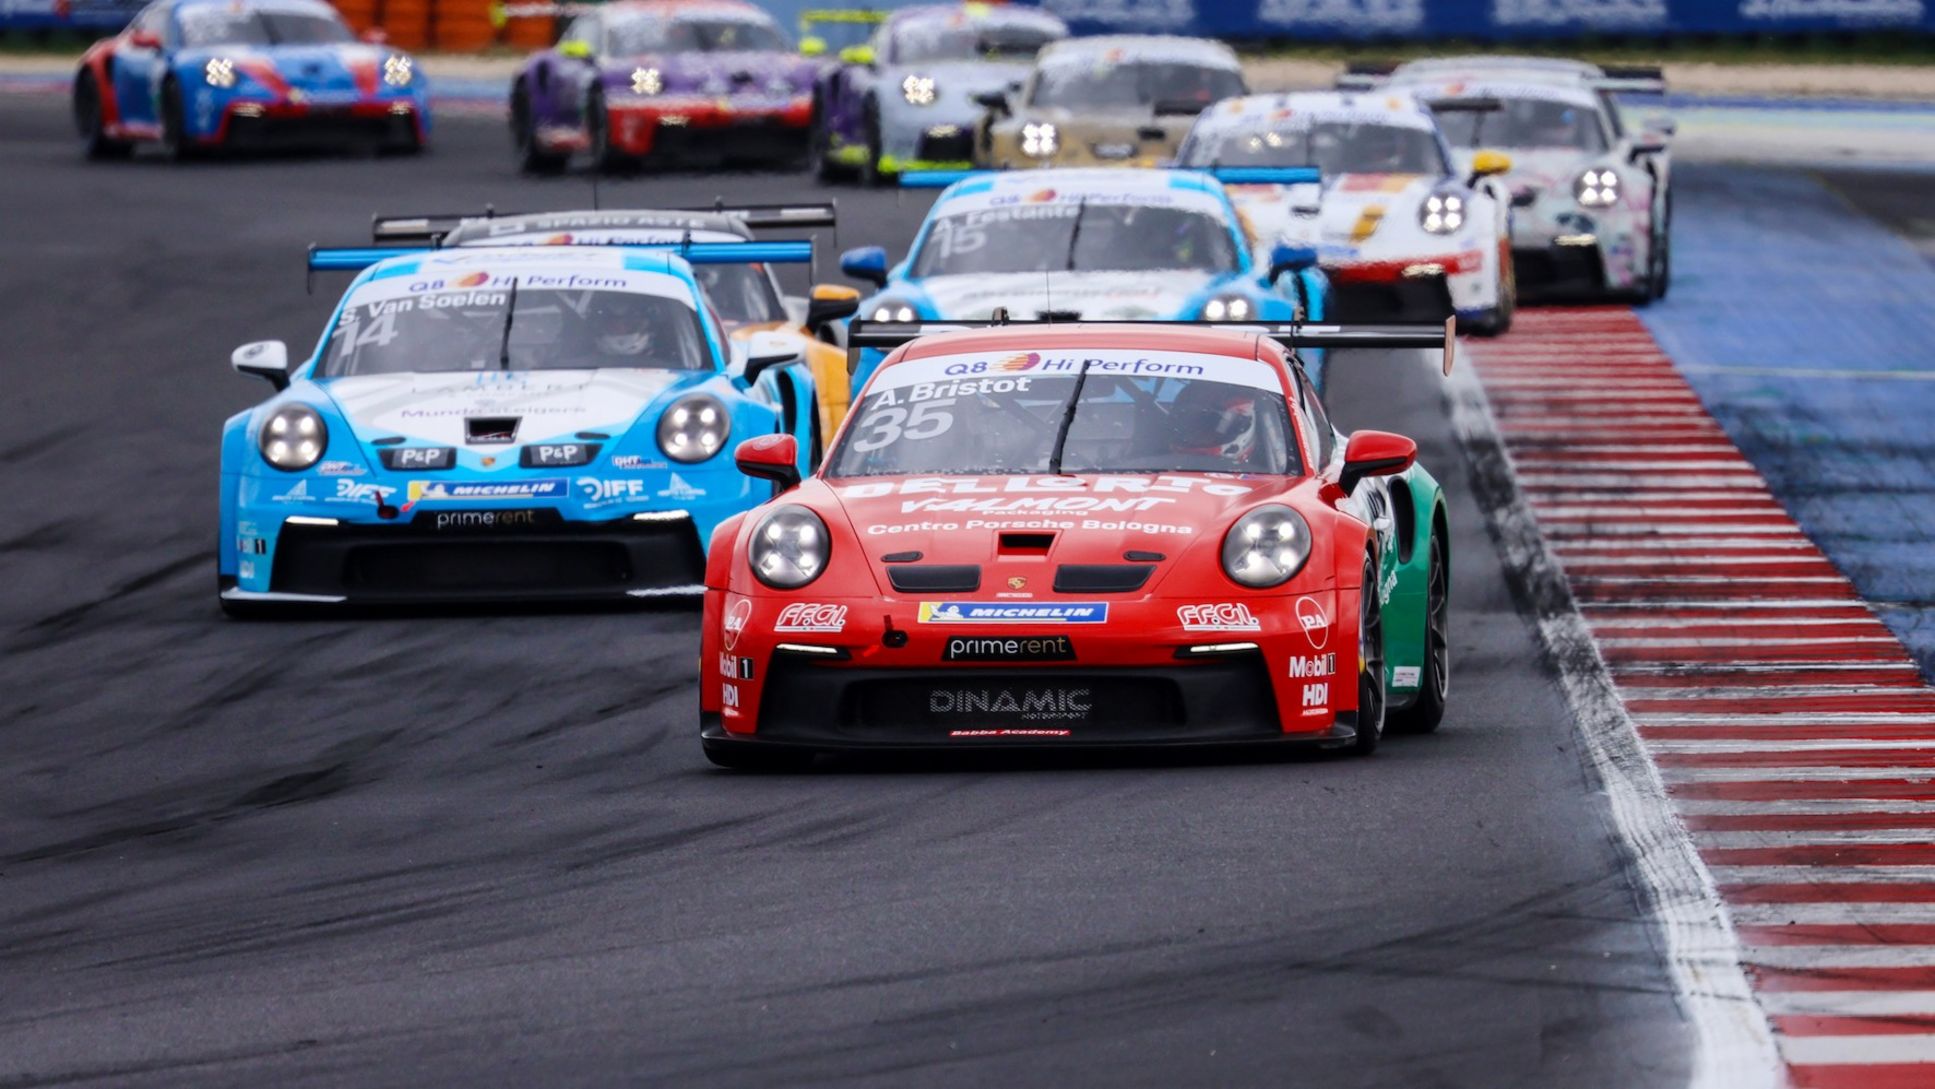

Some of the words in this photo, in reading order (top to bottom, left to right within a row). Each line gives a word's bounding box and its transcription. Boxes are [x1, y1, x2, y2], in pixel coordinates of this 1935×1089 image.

[931, 224, 986, 259] 15
[409, 279, 445, 293] Q8
[527, 274, 627, 288] Perform
[339, 308, 361, 326] S.
[367, 299, 413, 318] Van
[418, 291, 506, 310] Soelen
[332, 311, 398, 358] 14
[944, 361, 989, 377] Q8
[1042, 357, 1070, 372] Hi
[1088, 357, 1205, 376] Perform
[871, 391, 904, 411] A.
[908, 375, 1032, 402] Bristot
[853, 398, 956, 453] 35
[401, 448, 440, 465] P&P
[539, 445, 578, 461] P&P
[453, 482, 556, 496] MICHELIN
[576, 476, 644, 501] DIFF
[900, 497, 1176, 515] VALMONT
[983, 508, 1089, 517] Packaging
[437, 510, 535, 530] primerent
[867, 520, 958, 536] Centro
[966, 518, 1074, 531] Porsche
[1081, 519, 1193, 535] Bologna
[969, 608, 1095, 618] MICHELIN
[951, 636, 1068, 659] primerent
[1288, 653, 1327, 678] Mobil
[930, 688, 1092, 713] DINAMIC
[1302, 683, 1328, 707] HDI
